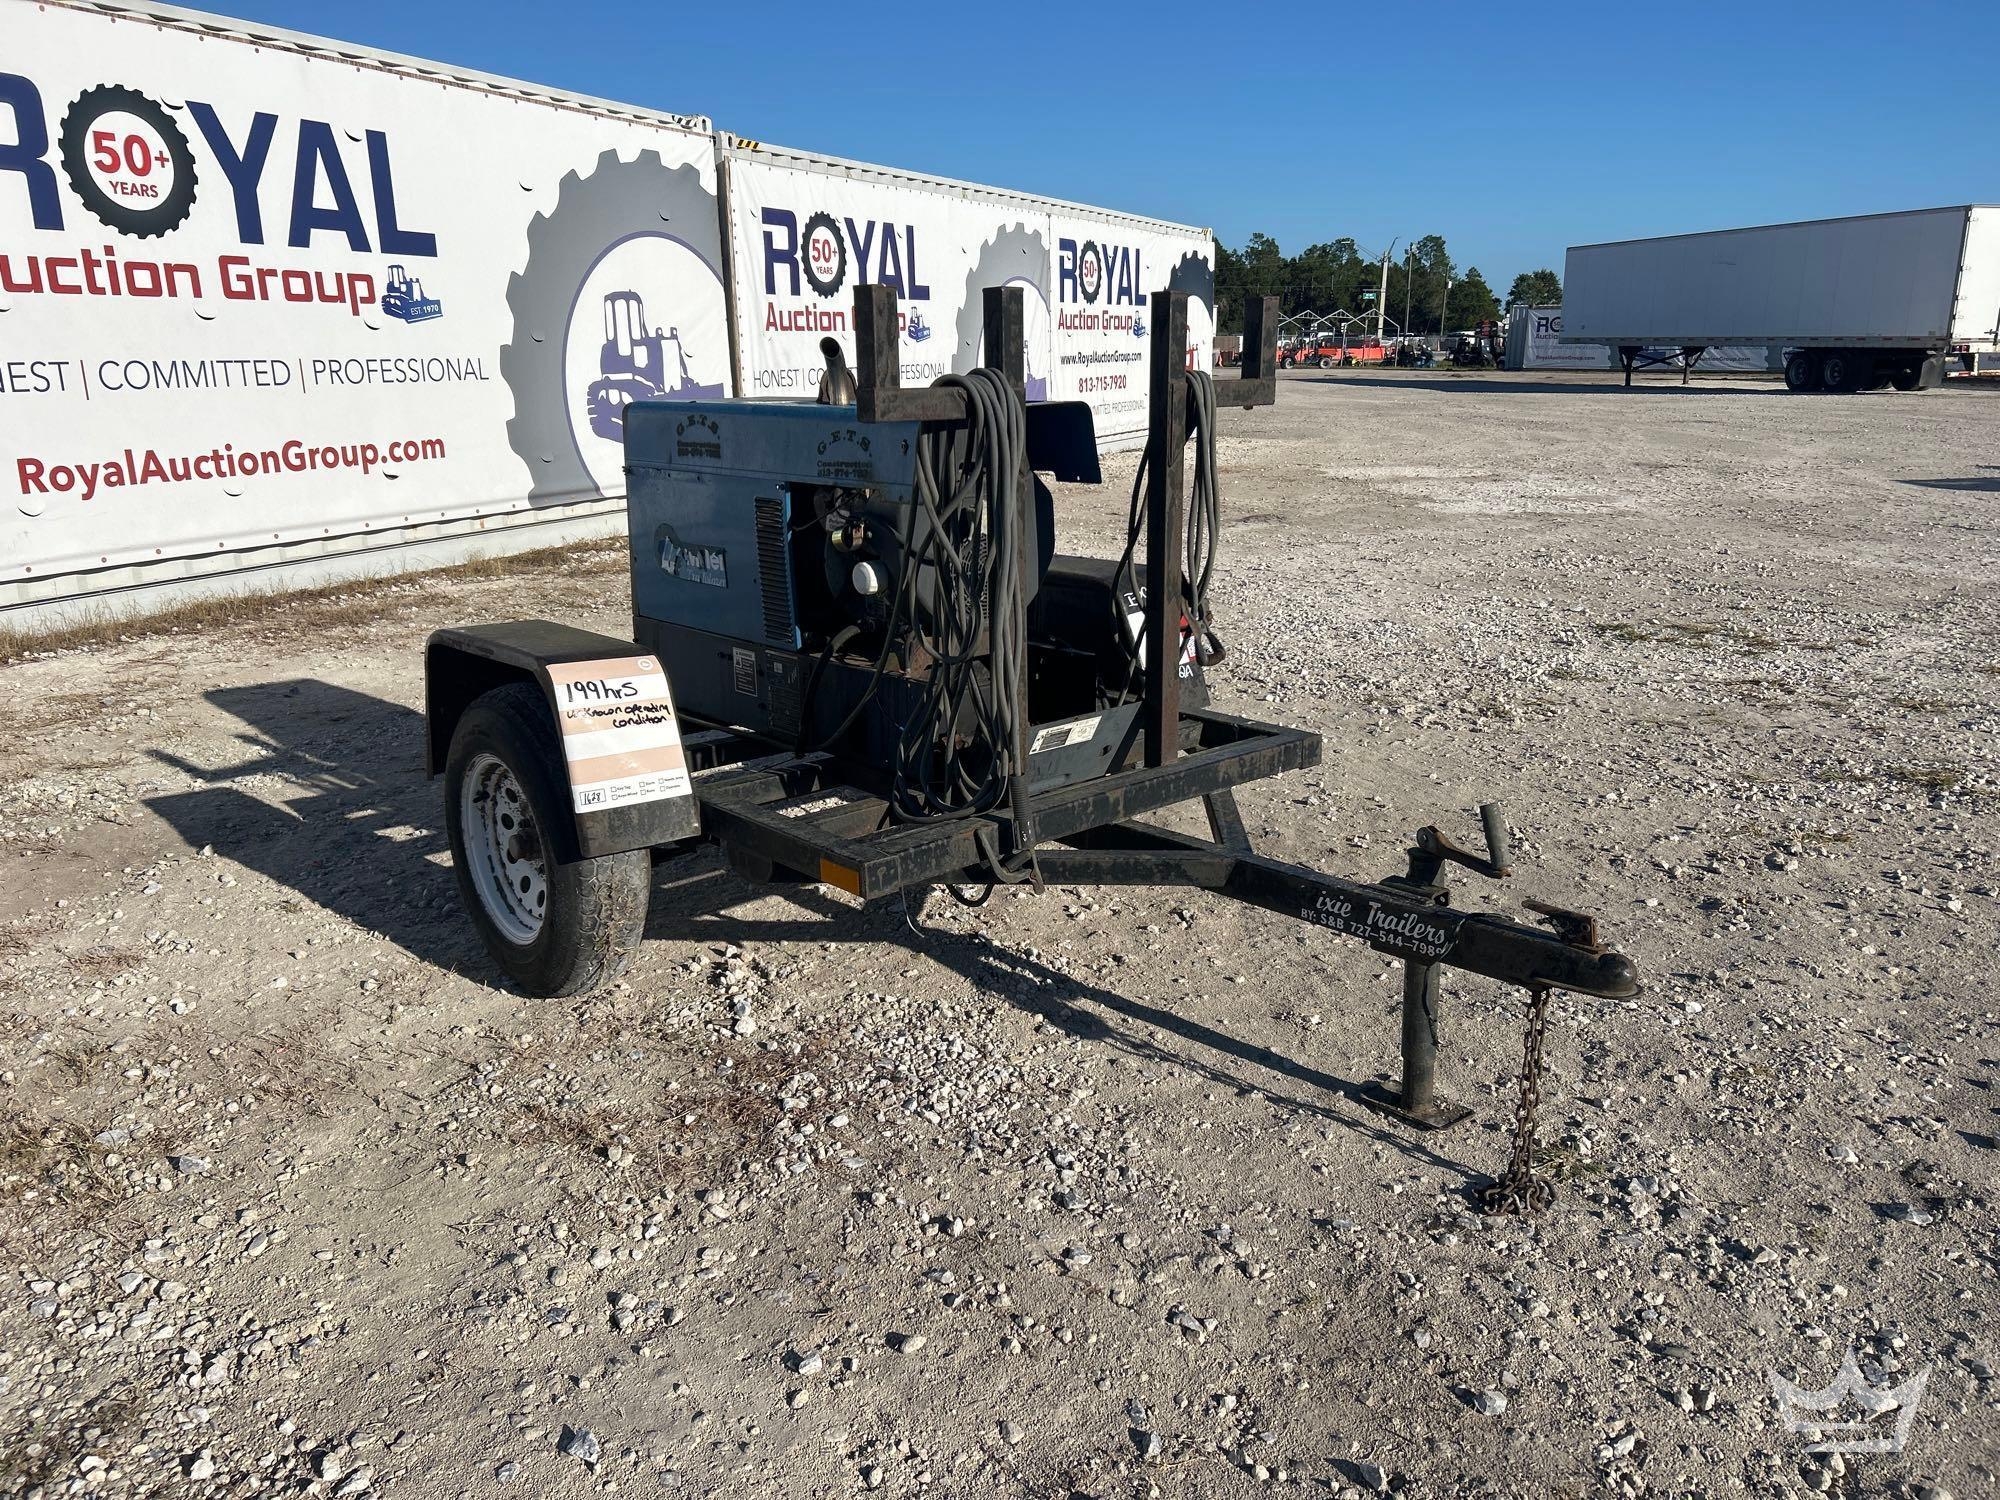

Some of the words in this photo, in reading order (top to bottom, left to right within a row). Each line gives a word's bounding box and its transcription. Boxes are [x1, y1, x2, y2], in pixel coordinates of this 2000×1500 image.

[92, 130, 169, 177] 50+
[108, 181, 159, 198] YEARS
[761, 206, 930, 300] ROYAL
[811, 238, 838, 263] 50+
[0, 244, 202, 299] uction
[218, 254, 377, 316] Group
[816, 266, 833, 275] YEARS
[1059, 238, 1147, 306] ROYAL
[423, 304, 439, 313] 1970
[765, 302, 846, 332] Auction
[1058, 308, 1100, 331] Auction
[1102, 309, 1133, 336] Group
[1060, 350, 1142, 367] www.RoyalAuctionGroup.com
[99, 358, 291, 392] COMMITTED
[313, 356, 490, 386] PROFESSIONAL
[753, 368, 800, 388] HONEST
[1078, 375, 1127, 393] 813-715-7920
[18, 434, 446, 500] RoyalAuctionGroup.com
[1301, 908, 1316, 922] BY:
[1320, 913, 1344, 929] S&B
[1366, 901, 1445, 944] Trailers
